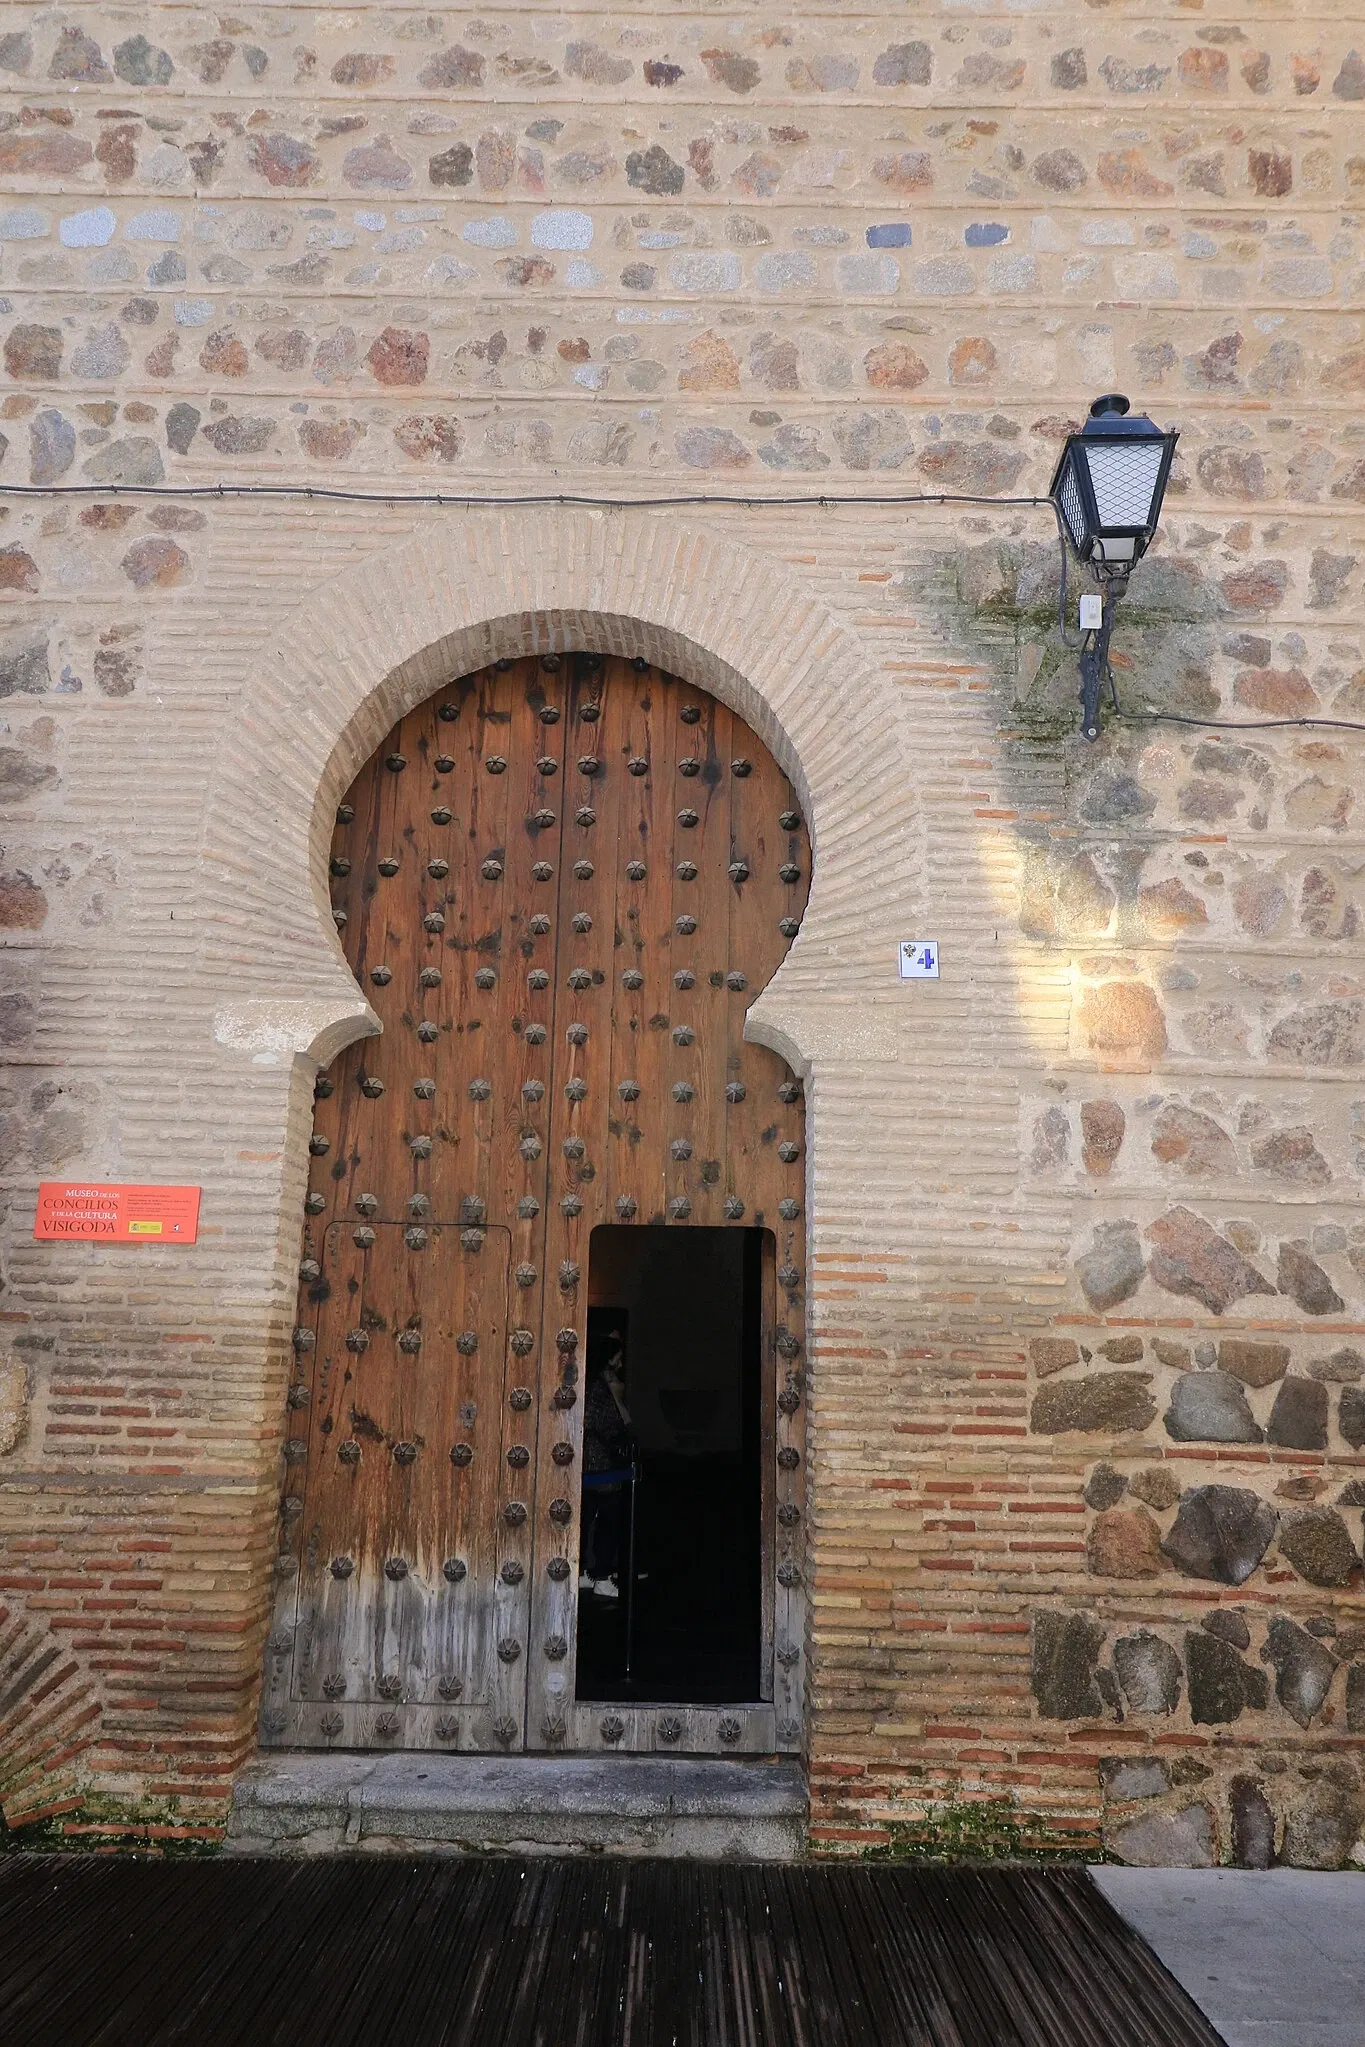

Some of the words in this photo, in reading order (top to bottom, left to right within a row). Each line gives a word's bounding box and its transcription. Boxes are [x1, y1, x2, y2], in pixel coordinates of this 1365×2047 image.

[917, 949, 935, 969] 4
[66, 1189, 99, 1198] MUSEO
[43, 1198, 119, 1210] CONCILIOS
[74, 1212, 117, 1220] CULTURA
[42, 1220, 115, 1233] VISIGODA
